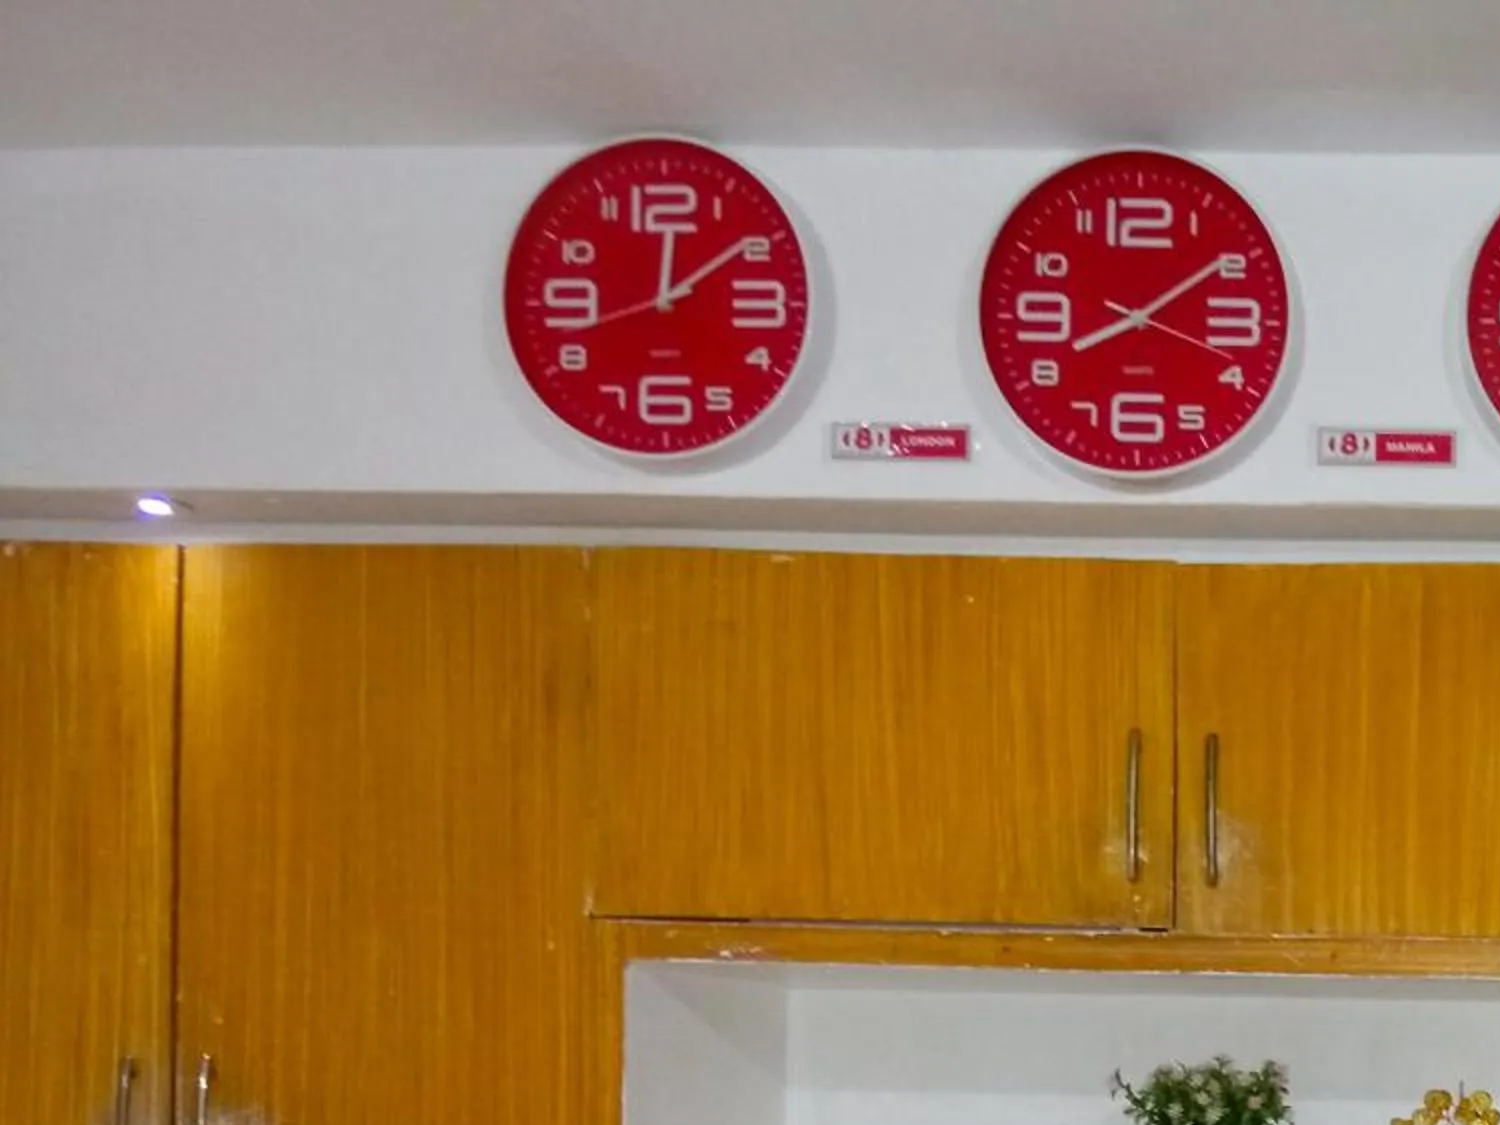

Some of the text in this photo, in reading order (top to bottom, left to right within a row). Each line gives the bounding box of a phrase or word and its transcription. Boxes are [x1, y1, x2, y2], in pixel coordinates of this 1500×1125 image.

[630, 184, 697, 233] 12
[1106, 197, 1173, 247] 12
[562, 240, 595, 264] 10
[741, 237, 771, 262] 2
[1035, 253, 1068, 277] 10
[1218, 253, 1246, 279] 2
[544, 278, 598, 328] 9
[732, 280, 786, 328] 3
[1016, 291, 1070, 342] 9
[1206, 297, 1260, 346] 3
[559, 344, 587, 370] 8
[745, 347, 771, 371] 4
[1031, 359, 1059, 386] 8
[1218, 365, 1244, 391] 4
[599, 384, 626, 411] 7
[639, 375, 692, 425] 6
[705, 386, 732, 411] 5
[1070, 401, 1097, 427] 7
[1111, 393, 1164, 442] 6
[1177, 405, 1205, 430] 5
